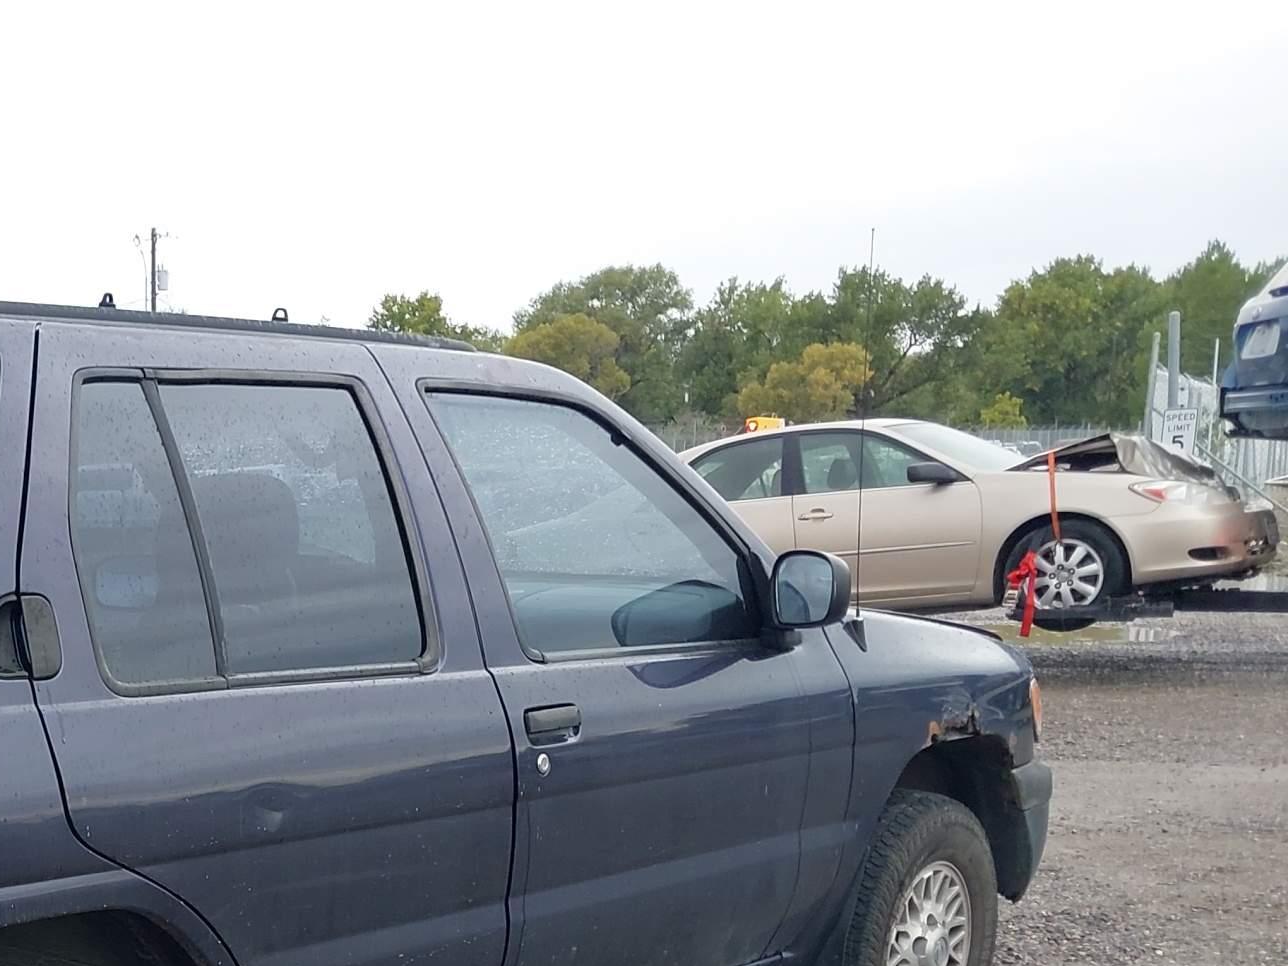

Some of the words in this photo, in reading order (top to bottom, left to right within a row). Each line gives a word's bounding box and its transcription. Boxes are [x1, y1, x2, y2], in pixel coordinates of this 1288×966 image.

[1166, 412, 1196, 422] SPEED
[1167, 423, 1191, 433] LIMIT
[1172, 434, 1184, 449] 5
